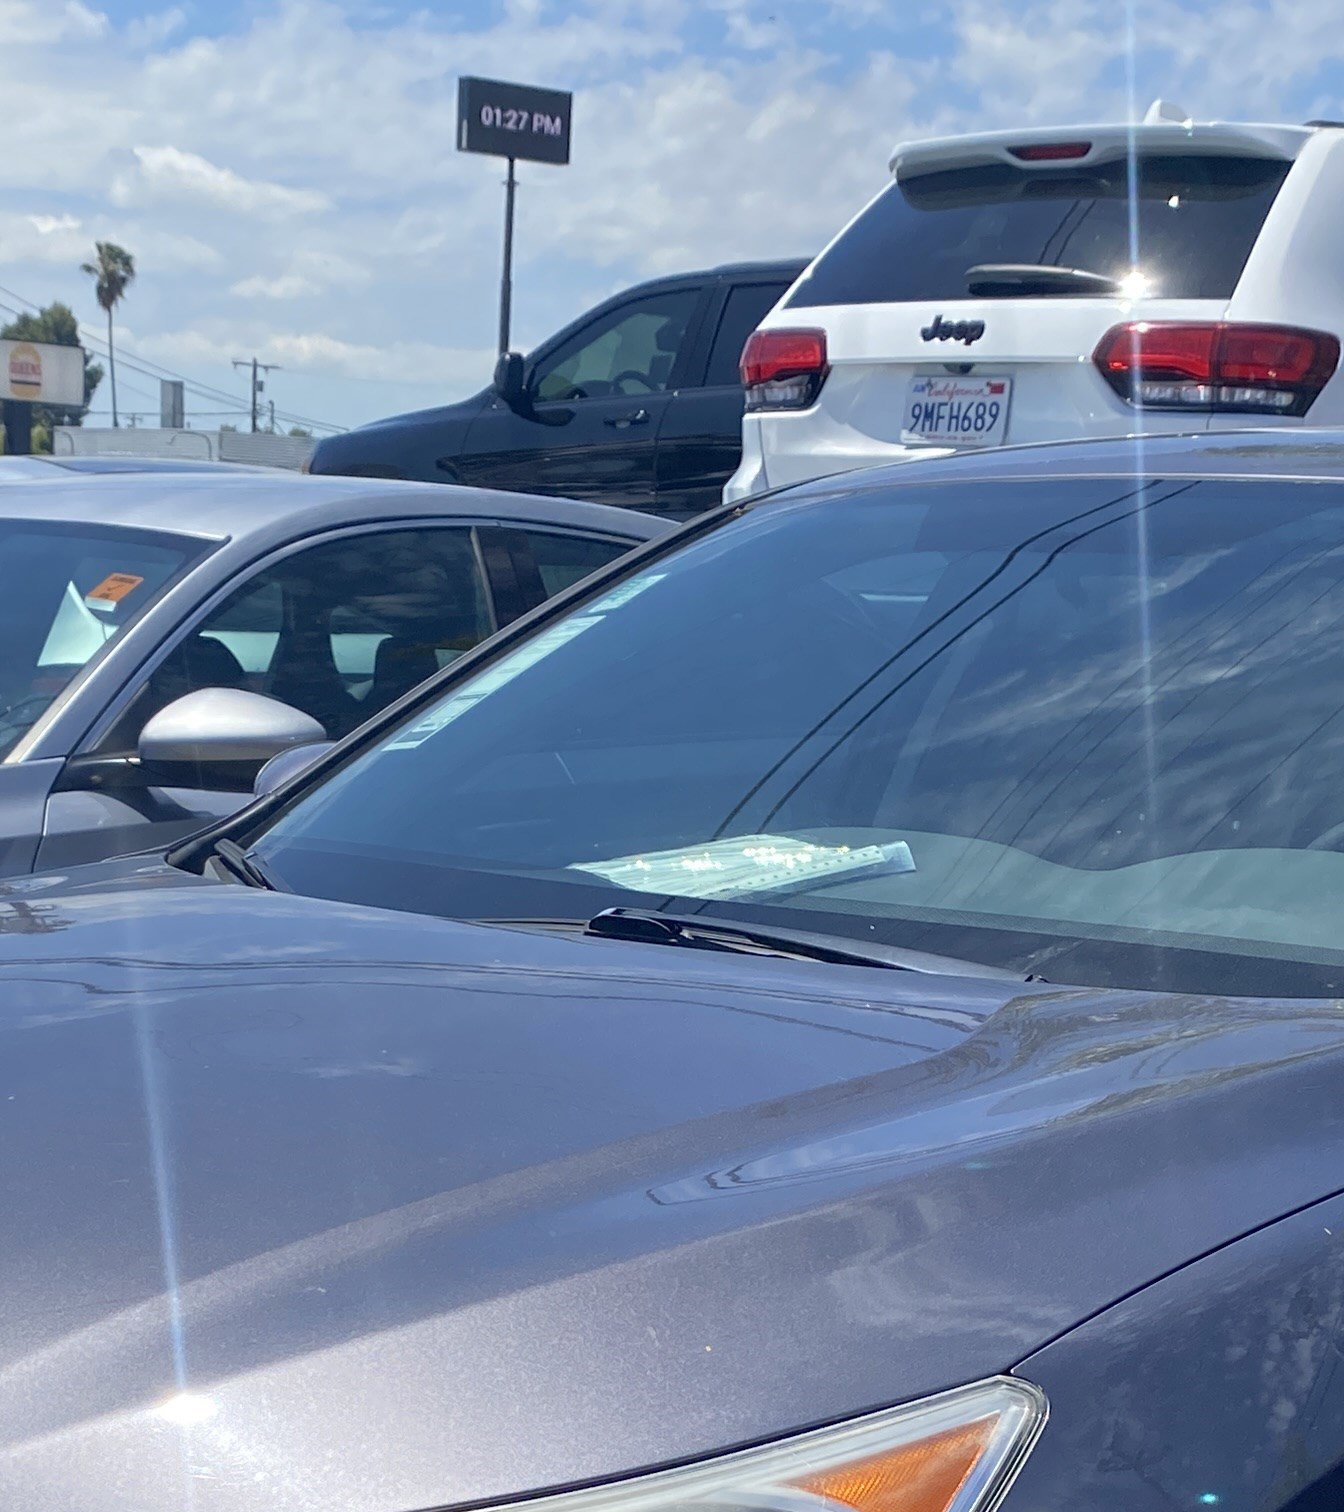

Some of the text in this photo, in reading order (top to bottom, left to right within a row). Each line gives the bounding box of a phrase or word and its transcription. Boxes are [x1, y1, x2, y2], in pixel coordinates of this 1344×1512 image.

[480, 105, 562, 136] 01:27 PM
[920, 314, 986, 346] Jeep
[909, 401, 1000, 432] 9MFH689
